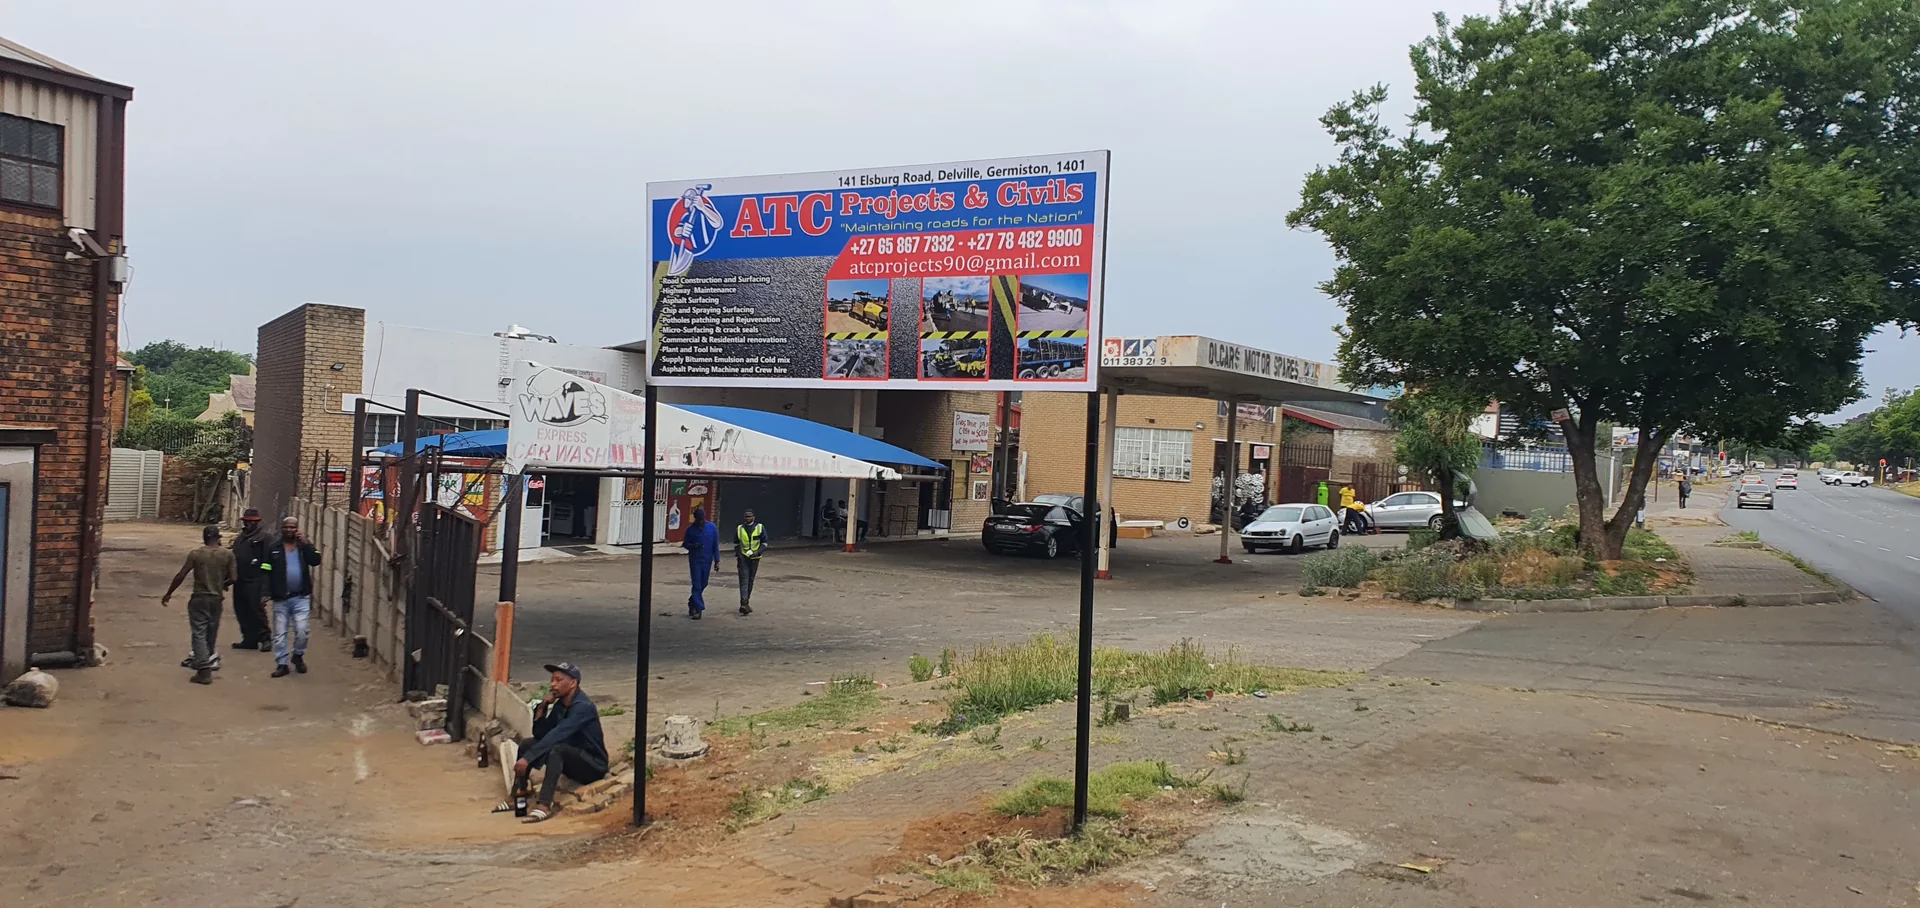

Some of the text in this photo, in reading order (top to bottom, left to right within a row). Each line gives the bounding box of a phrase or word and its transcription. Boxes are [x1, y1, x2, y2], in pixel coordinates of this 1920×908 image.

[838, 159, 1085, 188] 141 Elsburg Road, Delville, Germiston, 1401
[730, 178, 1084, 238] ATC Projects & Civils
[927, 215, 969, 229] roads
[972, 216, 994, 227] for
[998, 213, 1022, 225] the
[850, 238, 875, 255] +27
[878, 238, 894, 254] 65
[896, 236, 920, 253] 867
[924, 234, 955, 252] 7332
[967, 232, 994, 251] +27
[998, 231, 1014, 249] 78
[1018, 230, 1043, 248] 482
[1047, 228, 1082, 247] 9900
[849, 252, 1081, 277] atcprojects90@gmail.com
[738, 276, 770, 284] Surfacing
[688, 297, 719, 305] Surfacing
[692, 307, 721, 315] Spraying
[722, 306, 754, 315] Surfacing
[692, 317, 720, 325] patching
[736, 316, 780, 324] Rejuvenation
[688, 366, 710, 374] Paving
[1102, 358, 1120, 366] 011
[1122, 358, 1143, 366] 383
[1244, 348, 1270, 376] MOTOR
[1273, 355, 1300, 380] SPARES
[518, 391, 606, 422] WAVES
[537, 428, 588, 444] EXPRESS
[512, 442, 552, 461] CAR
[556, 444, 608, 465] WASH
